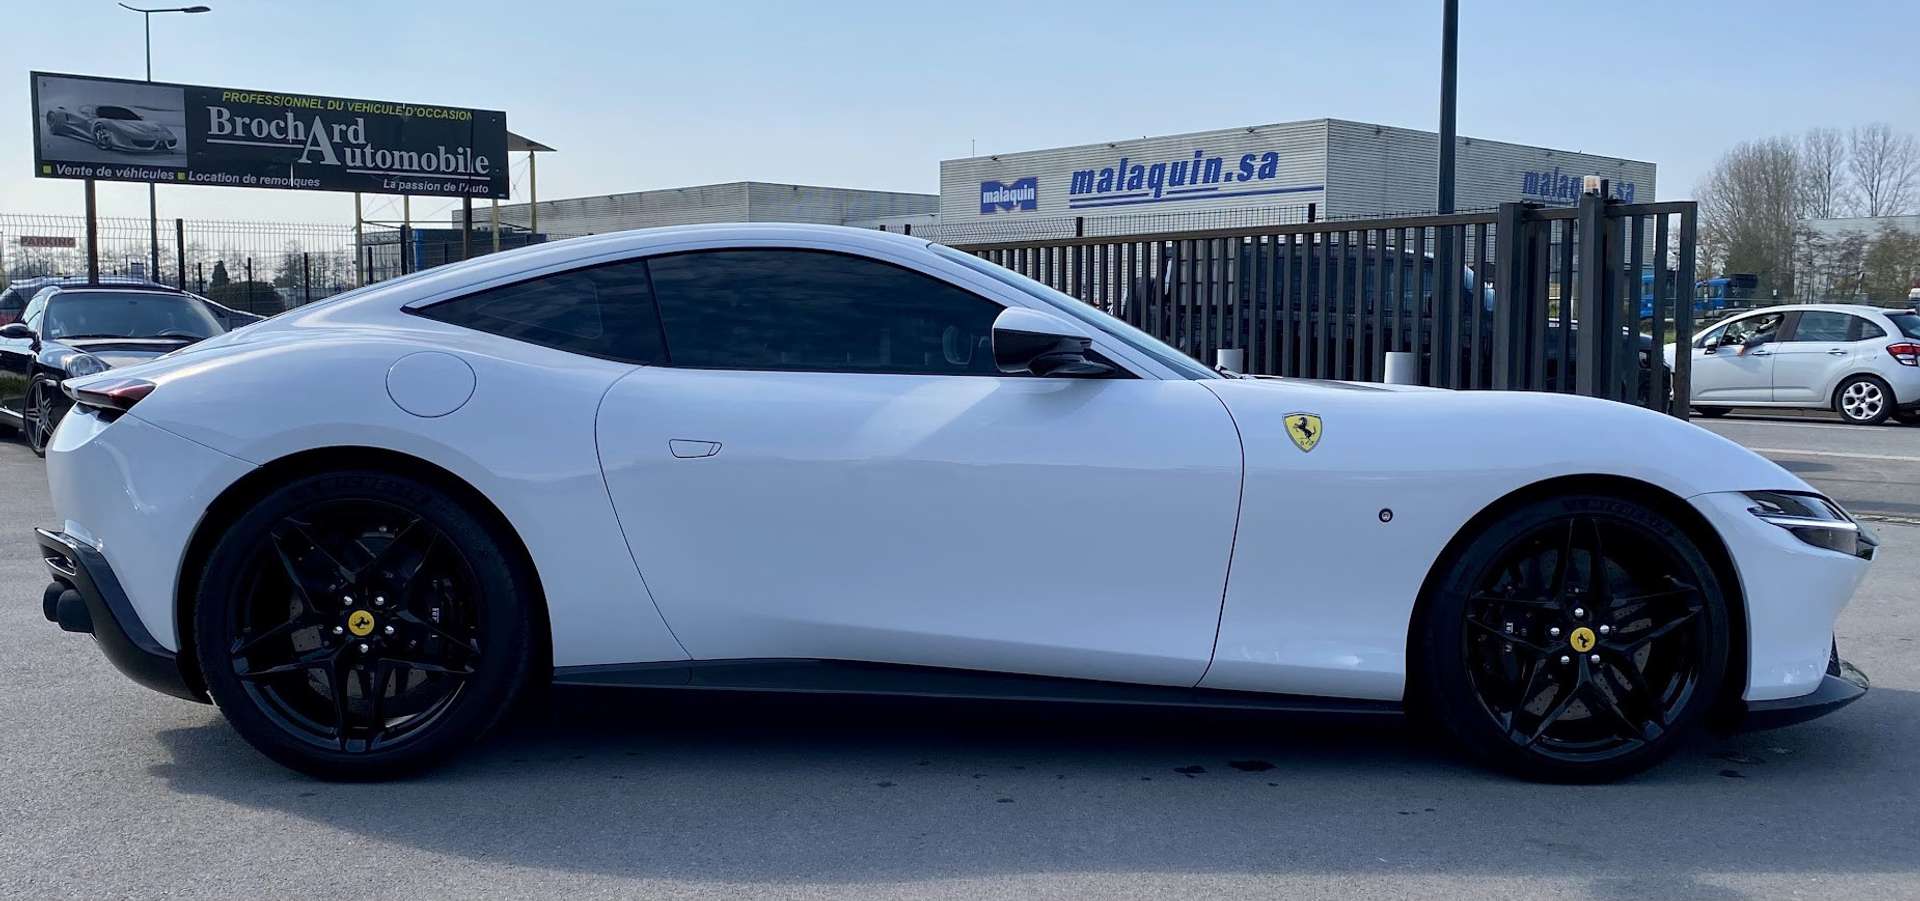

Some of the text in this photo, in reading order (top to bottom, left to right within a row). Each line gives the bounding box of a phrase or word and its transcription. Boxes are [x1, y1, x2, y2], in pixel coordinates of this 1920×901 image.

[222, 92, 324, 110] PROFESSIONNEL
[327, 100, 344, 111] DU
[348, 103, 403, 116] VEHICULE
[56, 164, 175, 180] Vente de véhicules
[188, 171, 240, 183] Location
[243, 174, 257, 184] de
[1070, 150, 1280, 198] malaquin.sa
[384, 179, 396, 189] La
[398, 181, 441, 193] passion
[444, 182, 456, 192] de
[983, 184, 1035, 205] malaquin
[21, 237, 75, 246] PARKING
